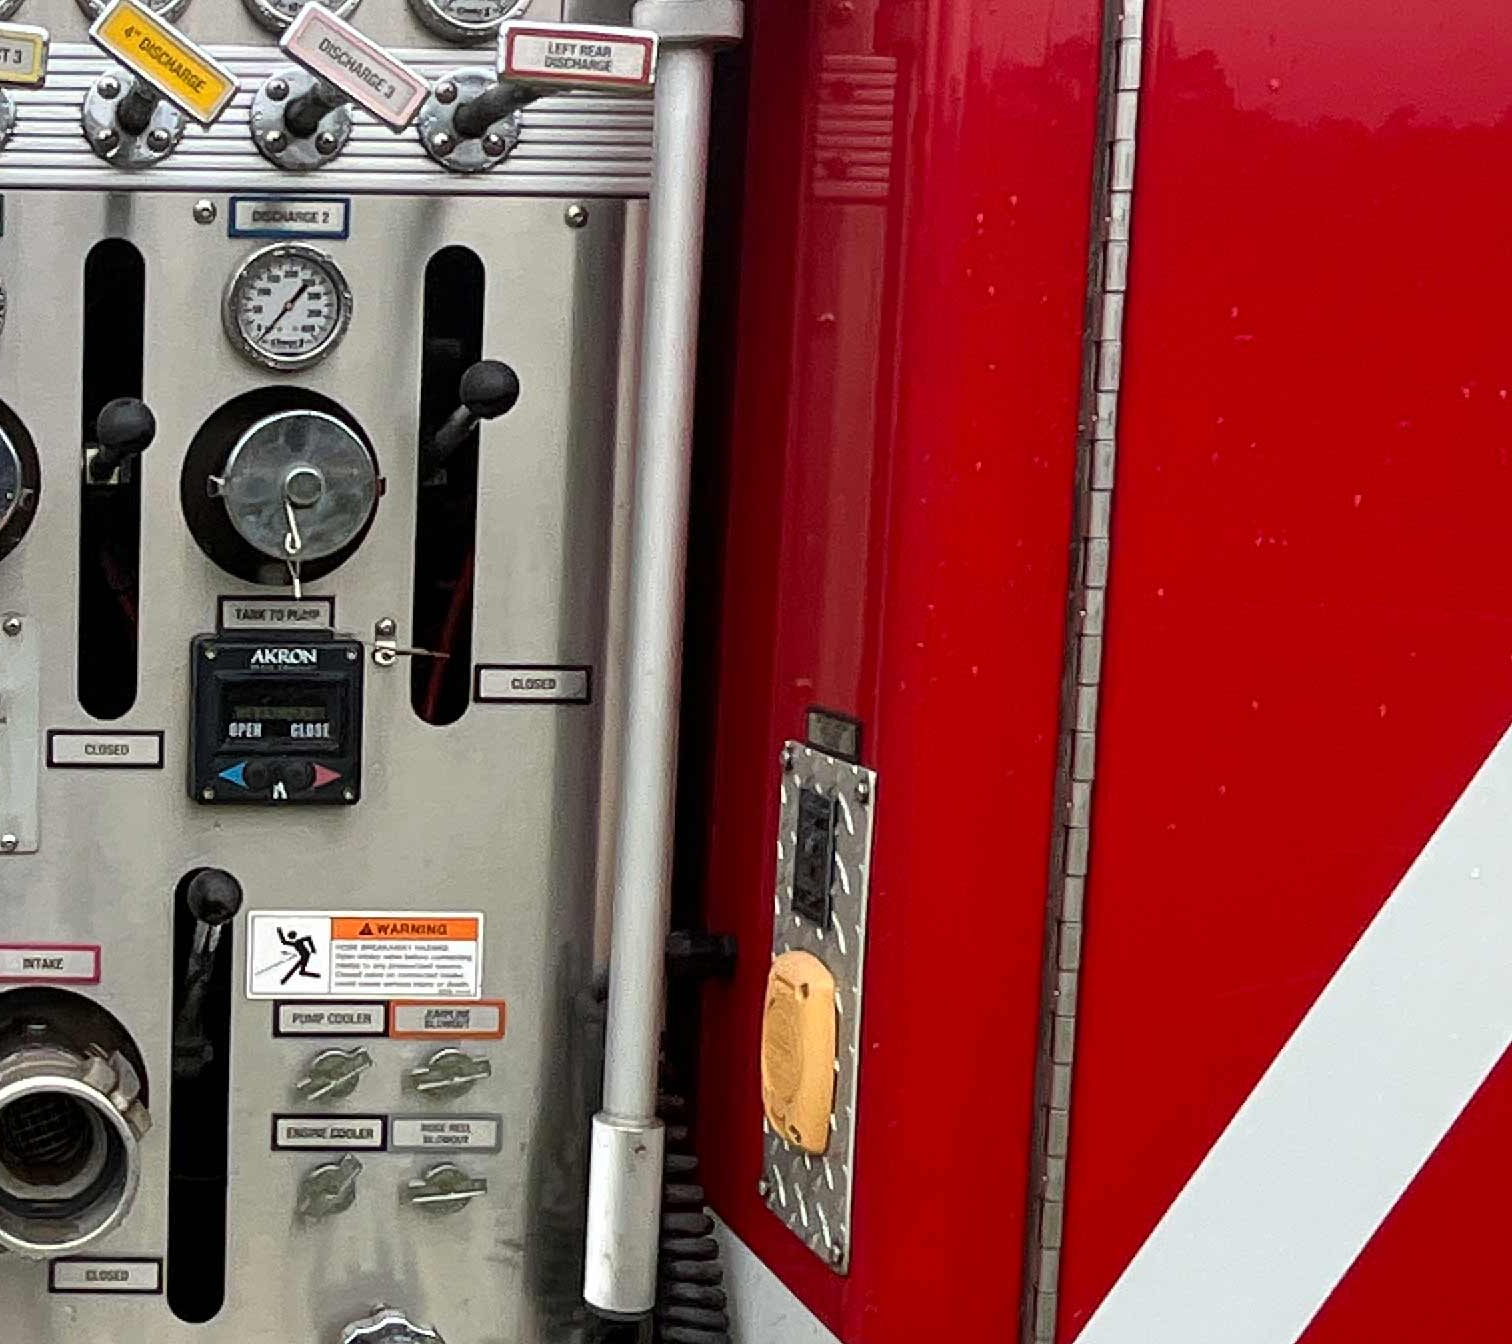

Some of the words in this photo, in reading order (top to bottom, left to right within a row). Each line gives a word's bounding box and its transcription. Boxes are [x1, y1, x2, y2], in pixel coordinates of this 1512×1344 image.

[12, 48, 23, 64] 3
[546, 42, 577, 56] LEFT
[580, 43, 612, 57] REAR
[139, 37, 208, 94] DISCHARGE
[317, 37, 388, 93] DISCHARGE
[544, 56, 612, 72] DISCHARGE
[252, 210, 319, 224] DISCHARGE
[322, 212, 330, 224] 2
[234, 608, 267, 621] TANK
[268, 608, 285, 621] TO
[250, 648, 318, 664] AKRON
[510, 678, 557, 690] CLOSED
[228, 722, 262, 738] OPEN
[84, 743, 130, 756] CLOSED
[377, 923, 448, 935] WARNING
[22, 957, 64, 970] INTAKE
[292, 1012, 324, 1024] PUMP
[326, 1012, 372, 1024] COOLER
[330, 1127, 374, 1139] COOLER
